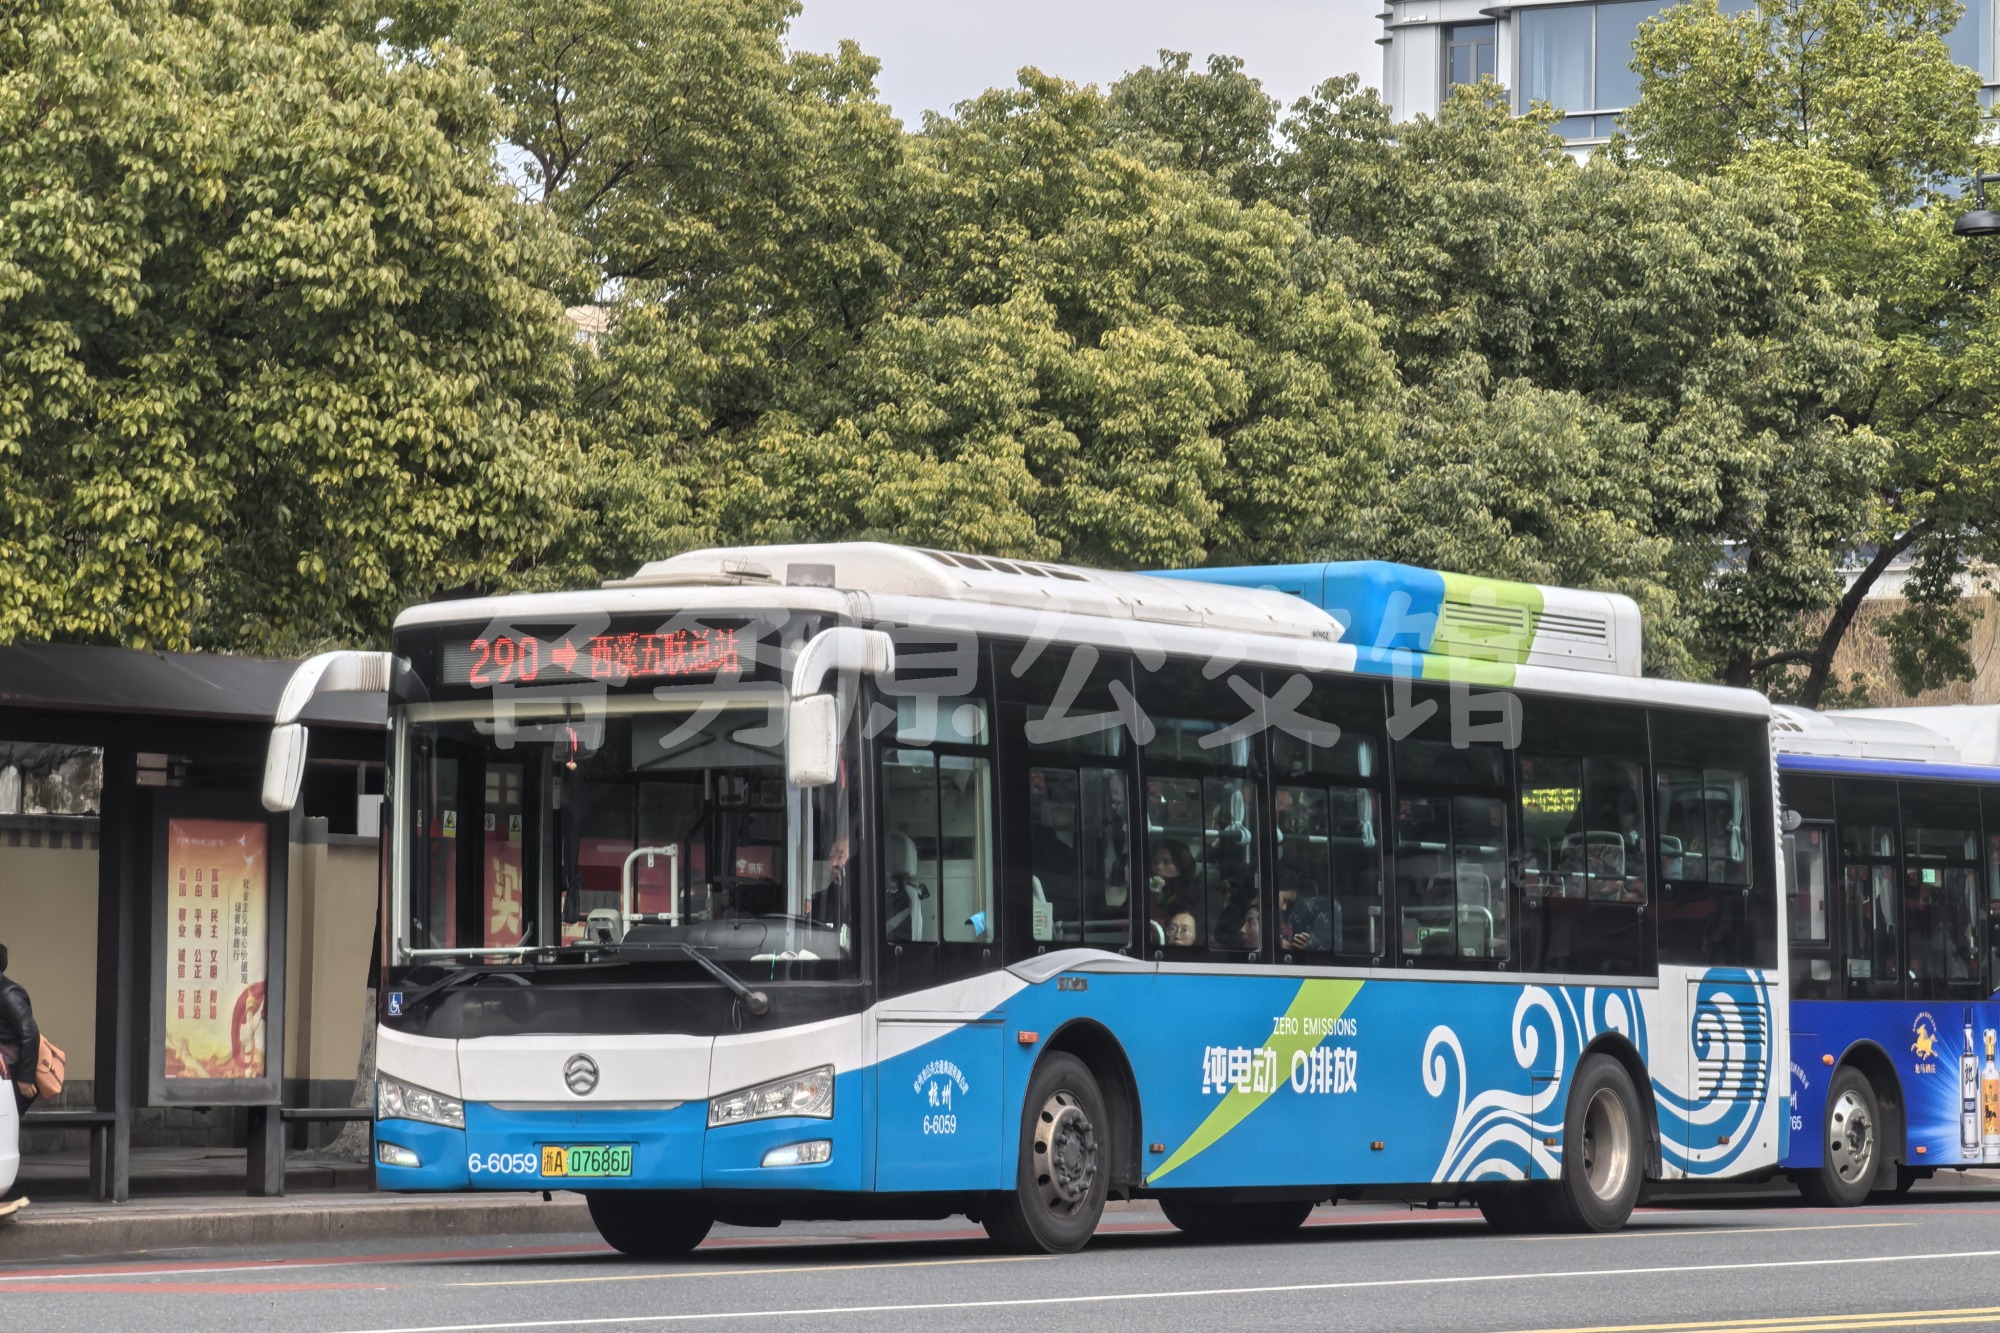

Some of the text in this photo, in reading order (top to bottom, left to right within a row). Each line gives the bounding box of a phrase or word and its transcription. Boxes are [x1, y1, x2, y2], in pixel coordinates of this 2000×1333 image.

[469, 627, 740, 683] 290 西溪五联总站
[211, 908, 218, 938] 民主
[193, 868, 202, 1020] 自由 平等 公正 法治
[210, 948, 218, 980] 文明
[1273, 1017, 1357, 1037] ZERO EMISSIONS
[1202, 1045, 1357, 1094] 纯电动 0排放
[928, 1079, 952, 1111] 杭州
[923, 1114, 957, 1134] 6-6059
[468, 1152, 538, 1173] 6-6059
